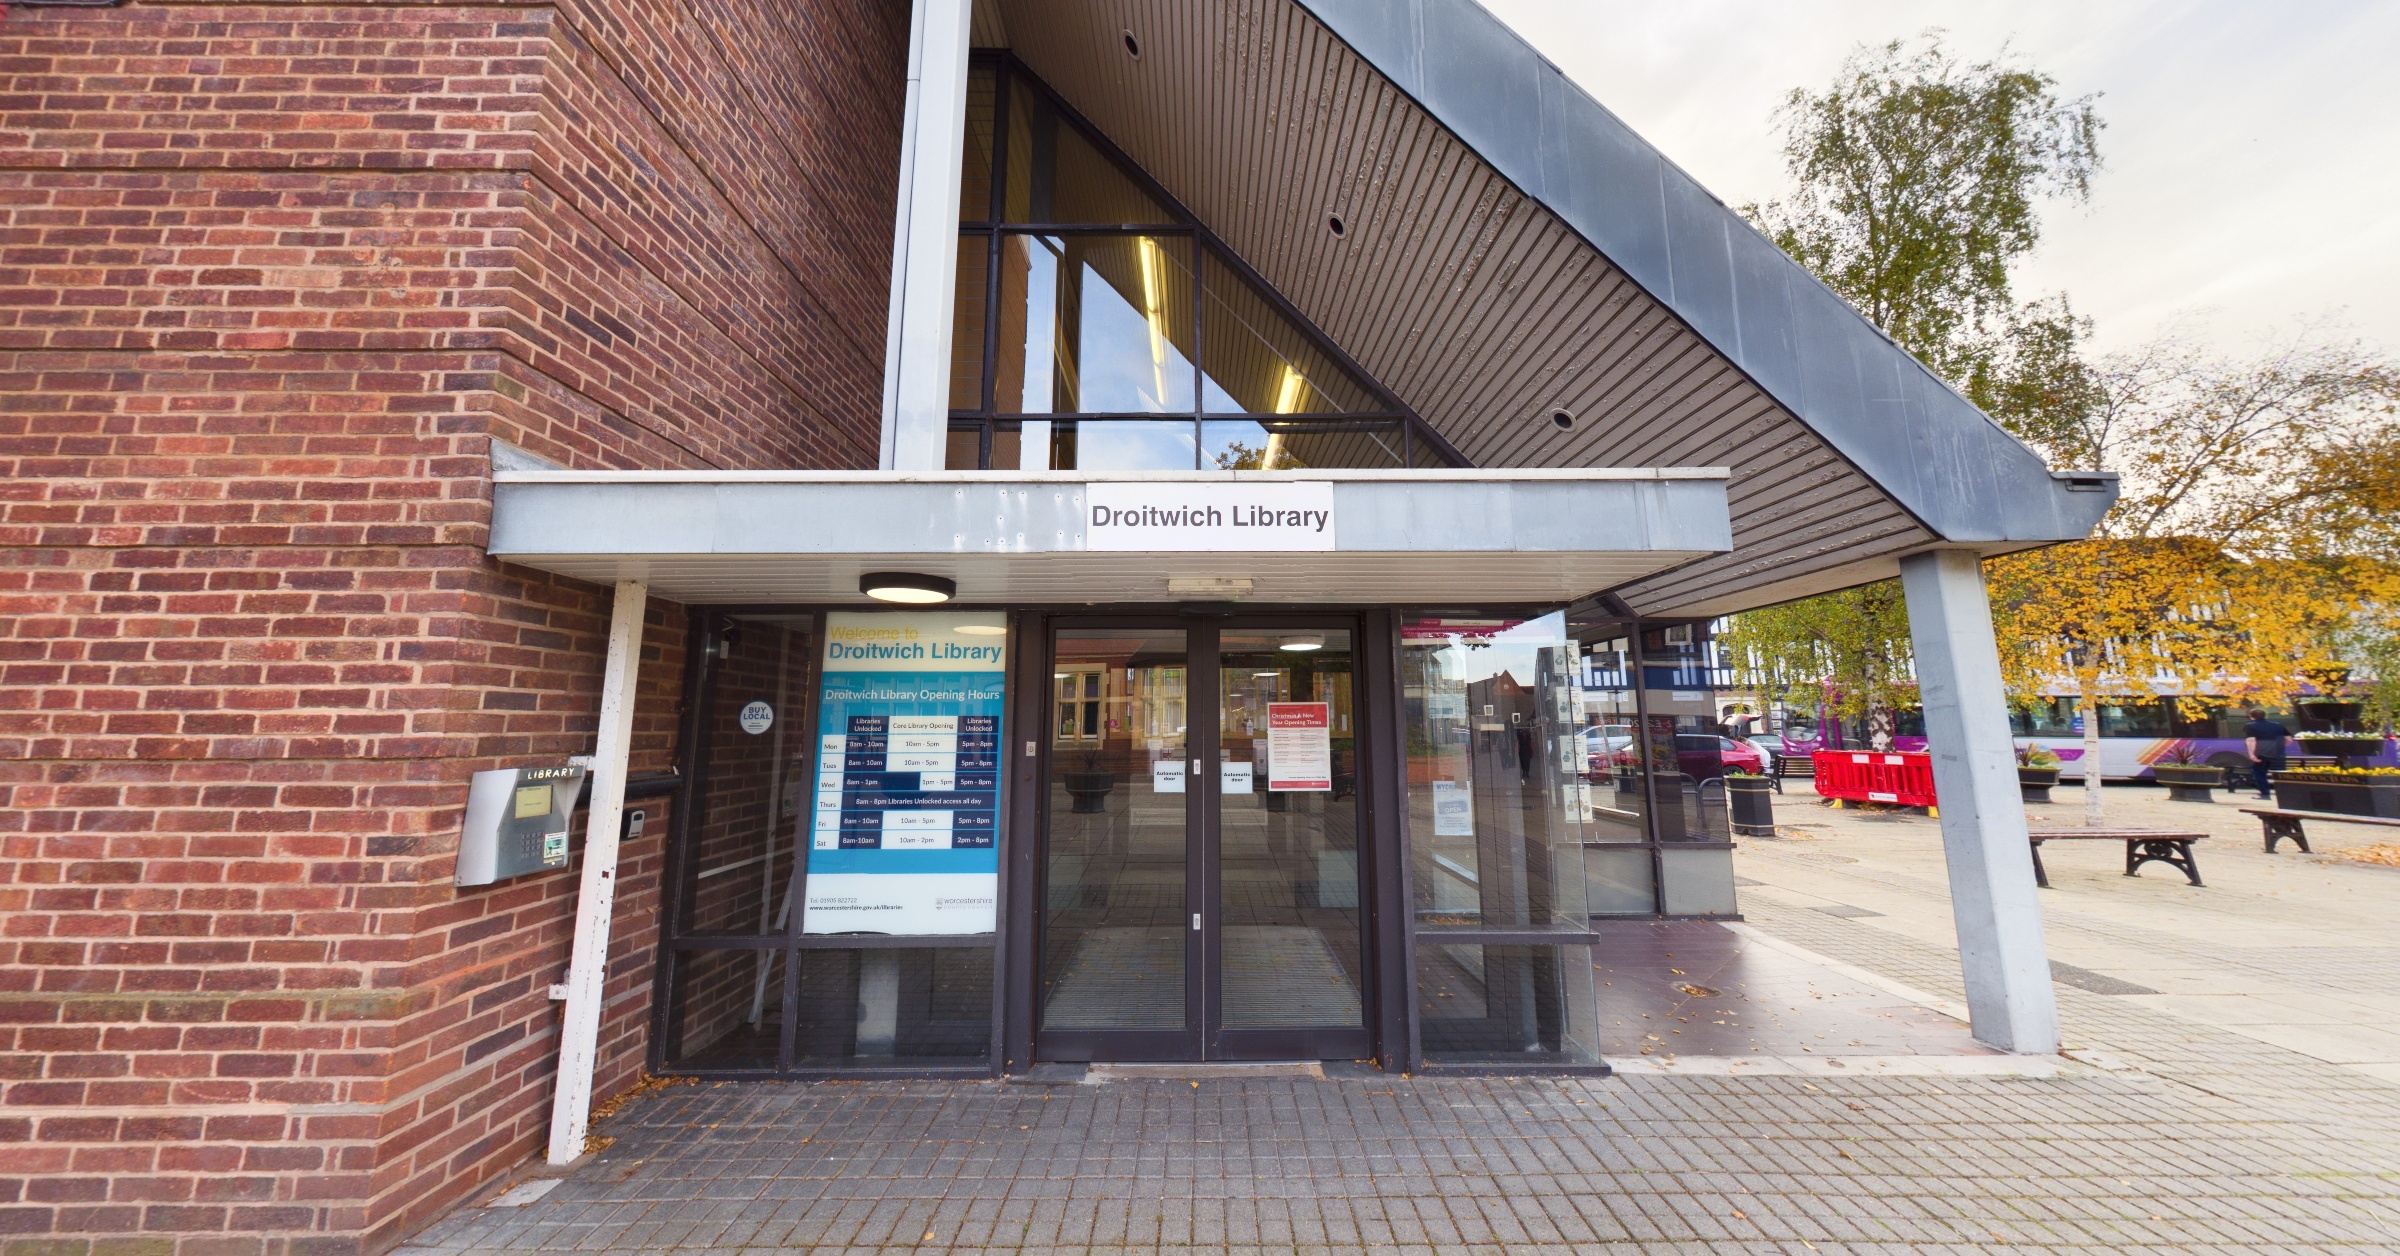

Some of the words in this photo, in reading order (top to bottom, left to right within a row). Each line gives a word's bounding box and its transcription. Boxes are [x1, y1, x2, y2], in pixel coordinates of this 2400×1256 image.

[1092, 505, 1222, 527] Droitwich
[1232, 505, 1329, 532] Library
[830, 627, 899, 640] Welcome
[904, 627, 919, 640] to
[829, 643, 924, 659] Droitwich
[931, 643, 1002, 663] Library
[825, 689, 878, 700] Droitwich
[880, 689, 918, 701] Library
[919, 689, 965, 702] Opening
[967, 689, 1000, 700] Hours
[908, 722, 928, 730] Library
[929, 722, 954, 730] Opening
[961, 760, 974, 768] 5pm
[527, 768, 575, 780] LIBRARY
[865, 778, 878, 786] 1pm
[970, 798, 982, 806] day
